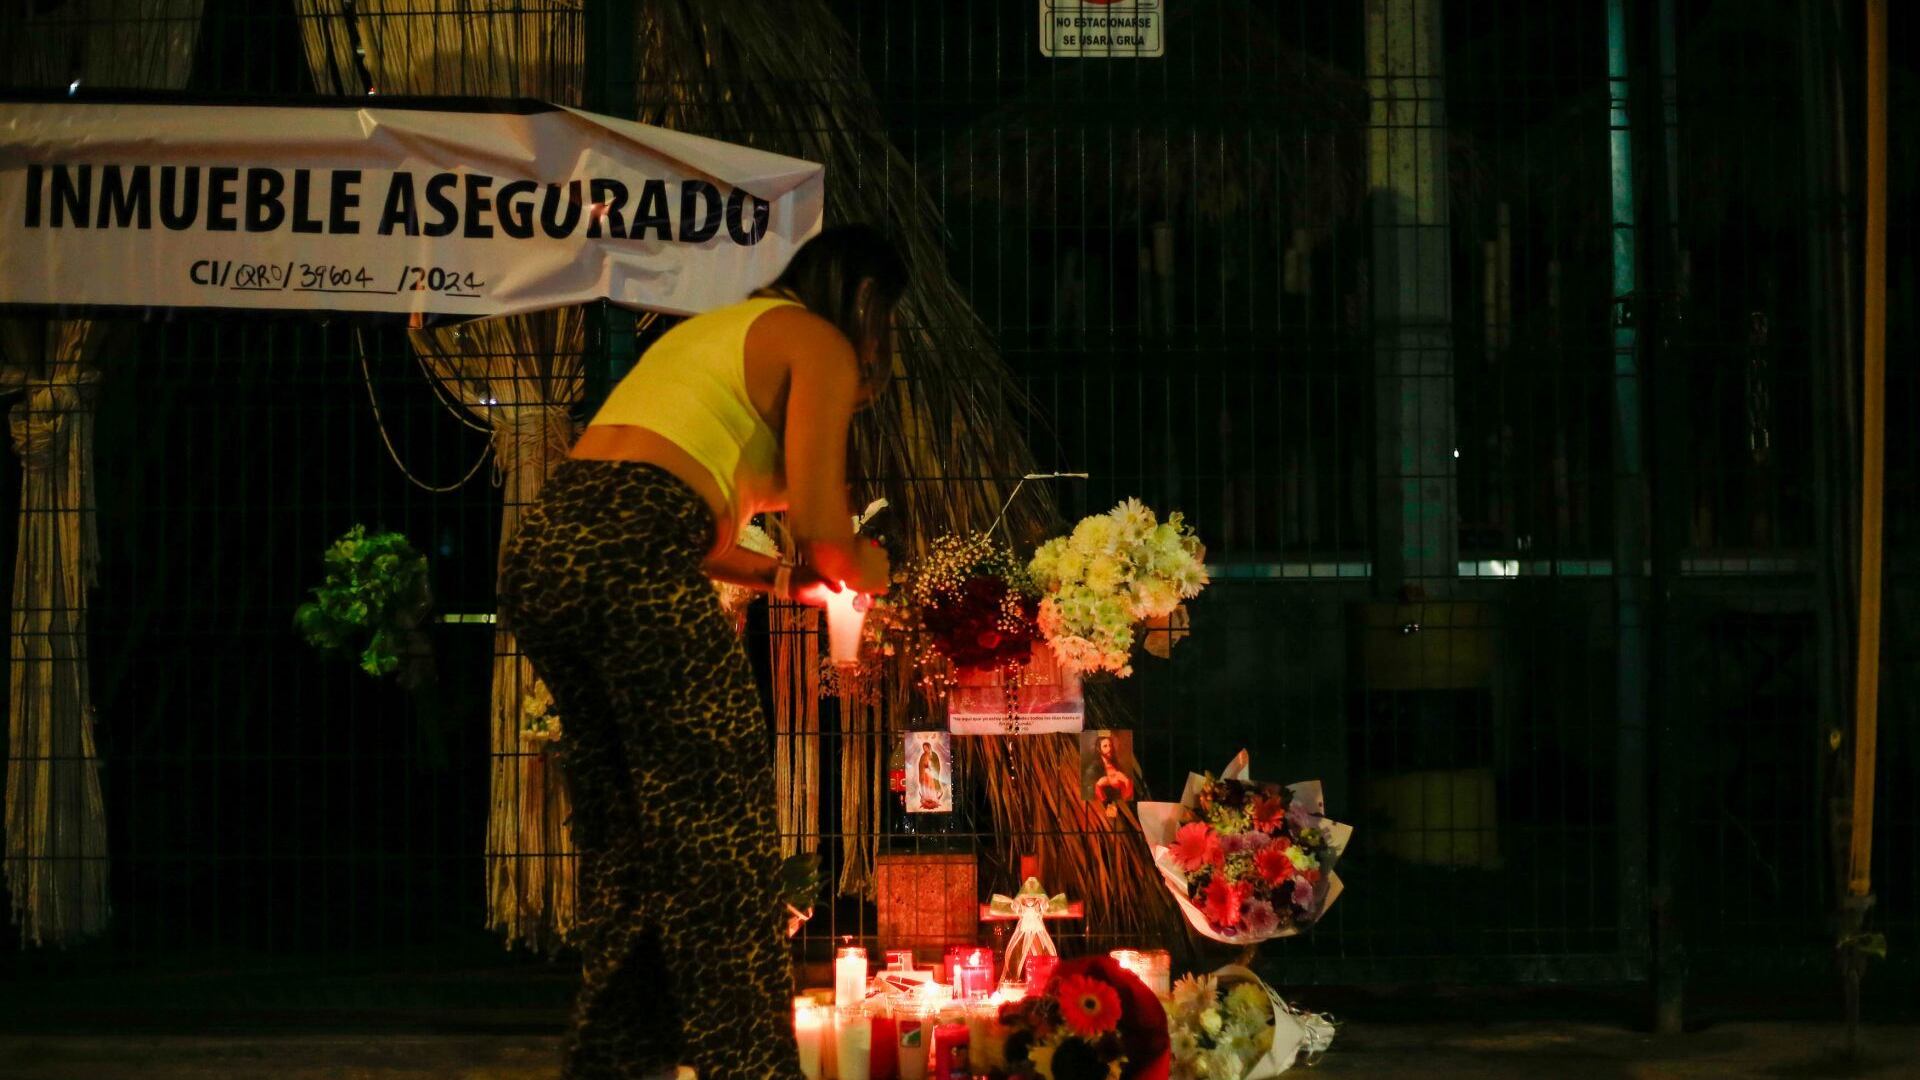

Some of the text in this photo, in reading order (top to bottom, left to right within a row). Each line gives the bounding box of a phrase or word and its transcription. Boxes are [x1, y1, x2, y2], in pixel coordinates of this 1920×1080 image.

[1056, 17, 1151, 28] NO ESTACONARSE
[1063, 35, 1145, 46] SE USARA GRUA
[25, 164, 770, 246] INMUEBLE ASEGURADO
